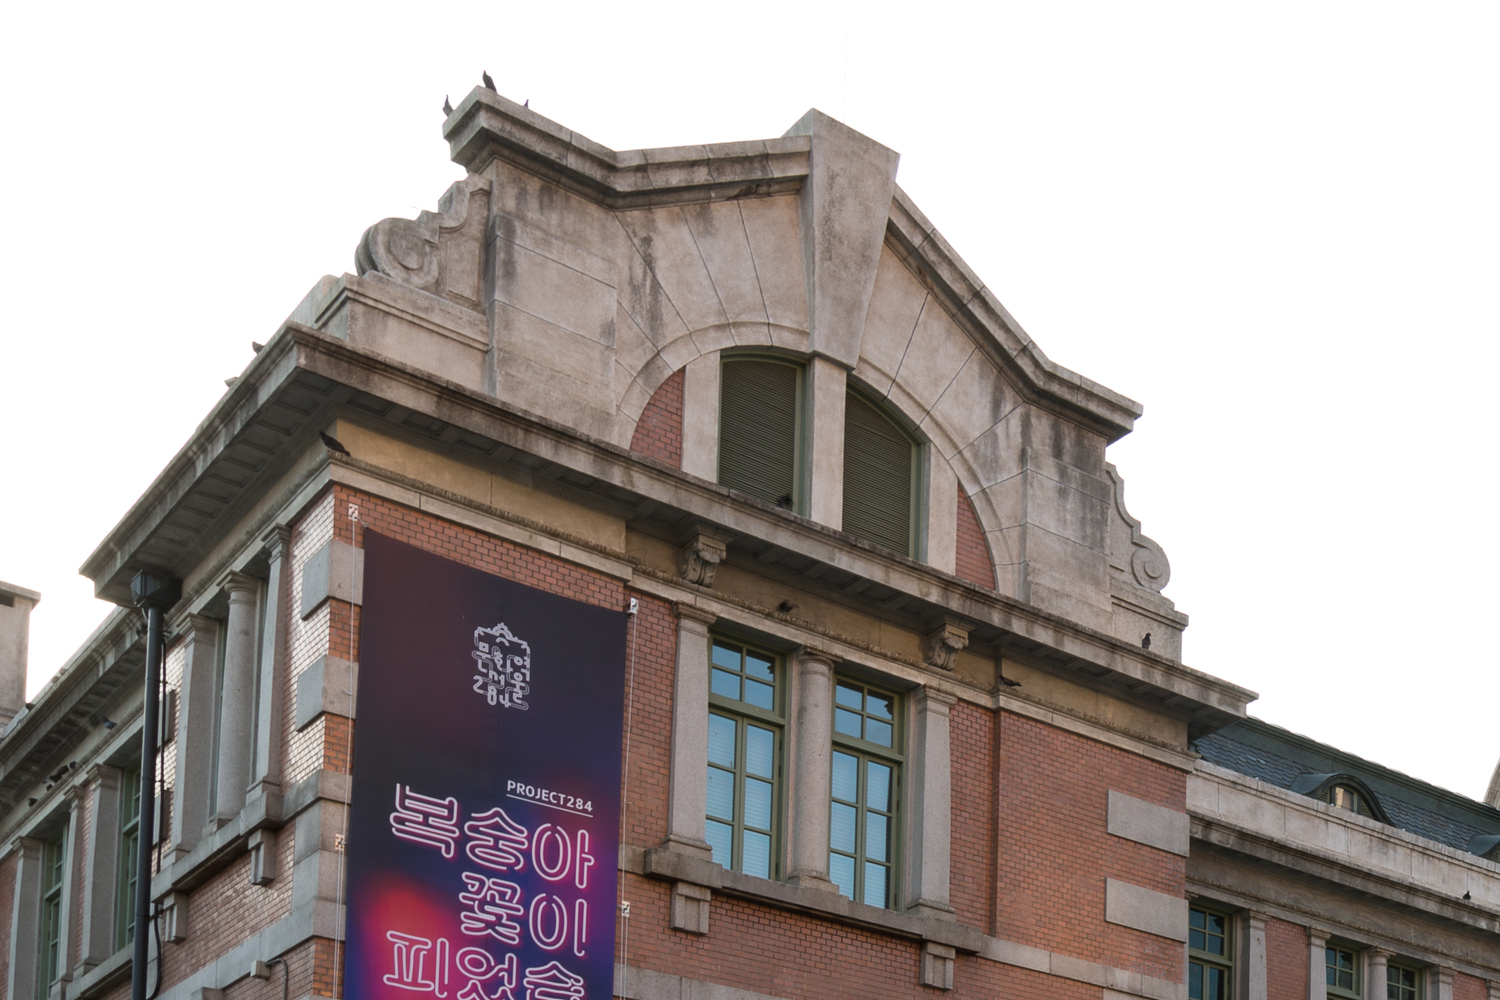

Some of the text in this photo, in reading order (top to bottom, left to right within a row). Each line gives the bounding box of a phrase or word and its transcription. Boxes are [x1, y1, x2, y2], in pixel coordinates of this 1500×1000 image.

[390, 783, 594, 890] 복숭아
[507, 780, 593, 812] PROJECT284
[459, 872, 587, 957] 꽃이
